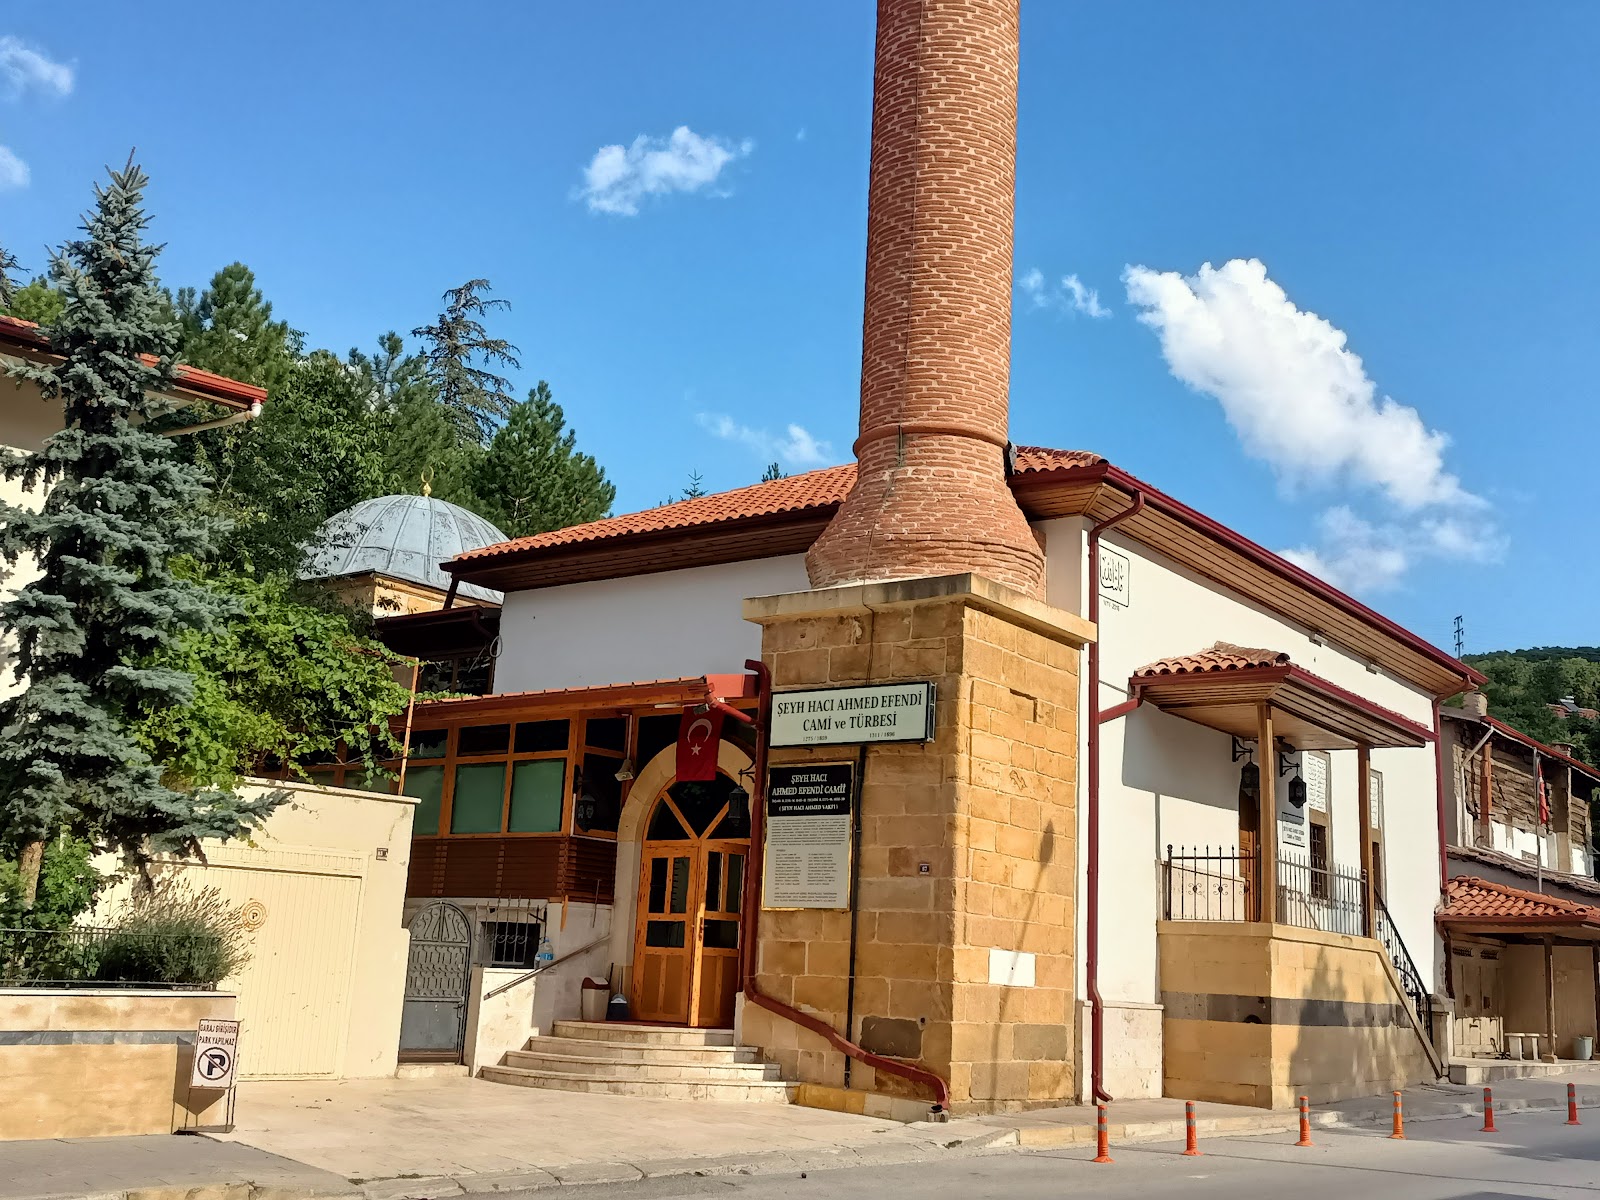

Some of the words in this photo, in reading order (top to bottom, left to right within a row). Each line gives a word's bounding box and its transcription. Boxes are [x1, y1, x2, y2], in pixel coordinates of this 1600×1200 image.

[777, 701, 805, 717] ŞEYH
[808, 699, 834, 713] HACI
[837, 696, 879, 711] AHMED
[881, 690, 922, 708] EFENDİ
[803, 715, 832, 731] CAMİ
[834, 720, 846, 729] ve
[849, 711, 897, 729] TÜRBESİ
[791, 774, 810, 785] ŞEYH
[810, 773, 828, 782] HACI
[772, 787, 797, 796] AHMED
[798, 784, 824, 794] EFENDİ
[824, 783, 846, 793] CAMİİ
[200, 1024, 215, 1033] GARAJ
[199, 1035, 211, 1044] PARK
[212, 1036, 235, 1045] YAPILMAZ
